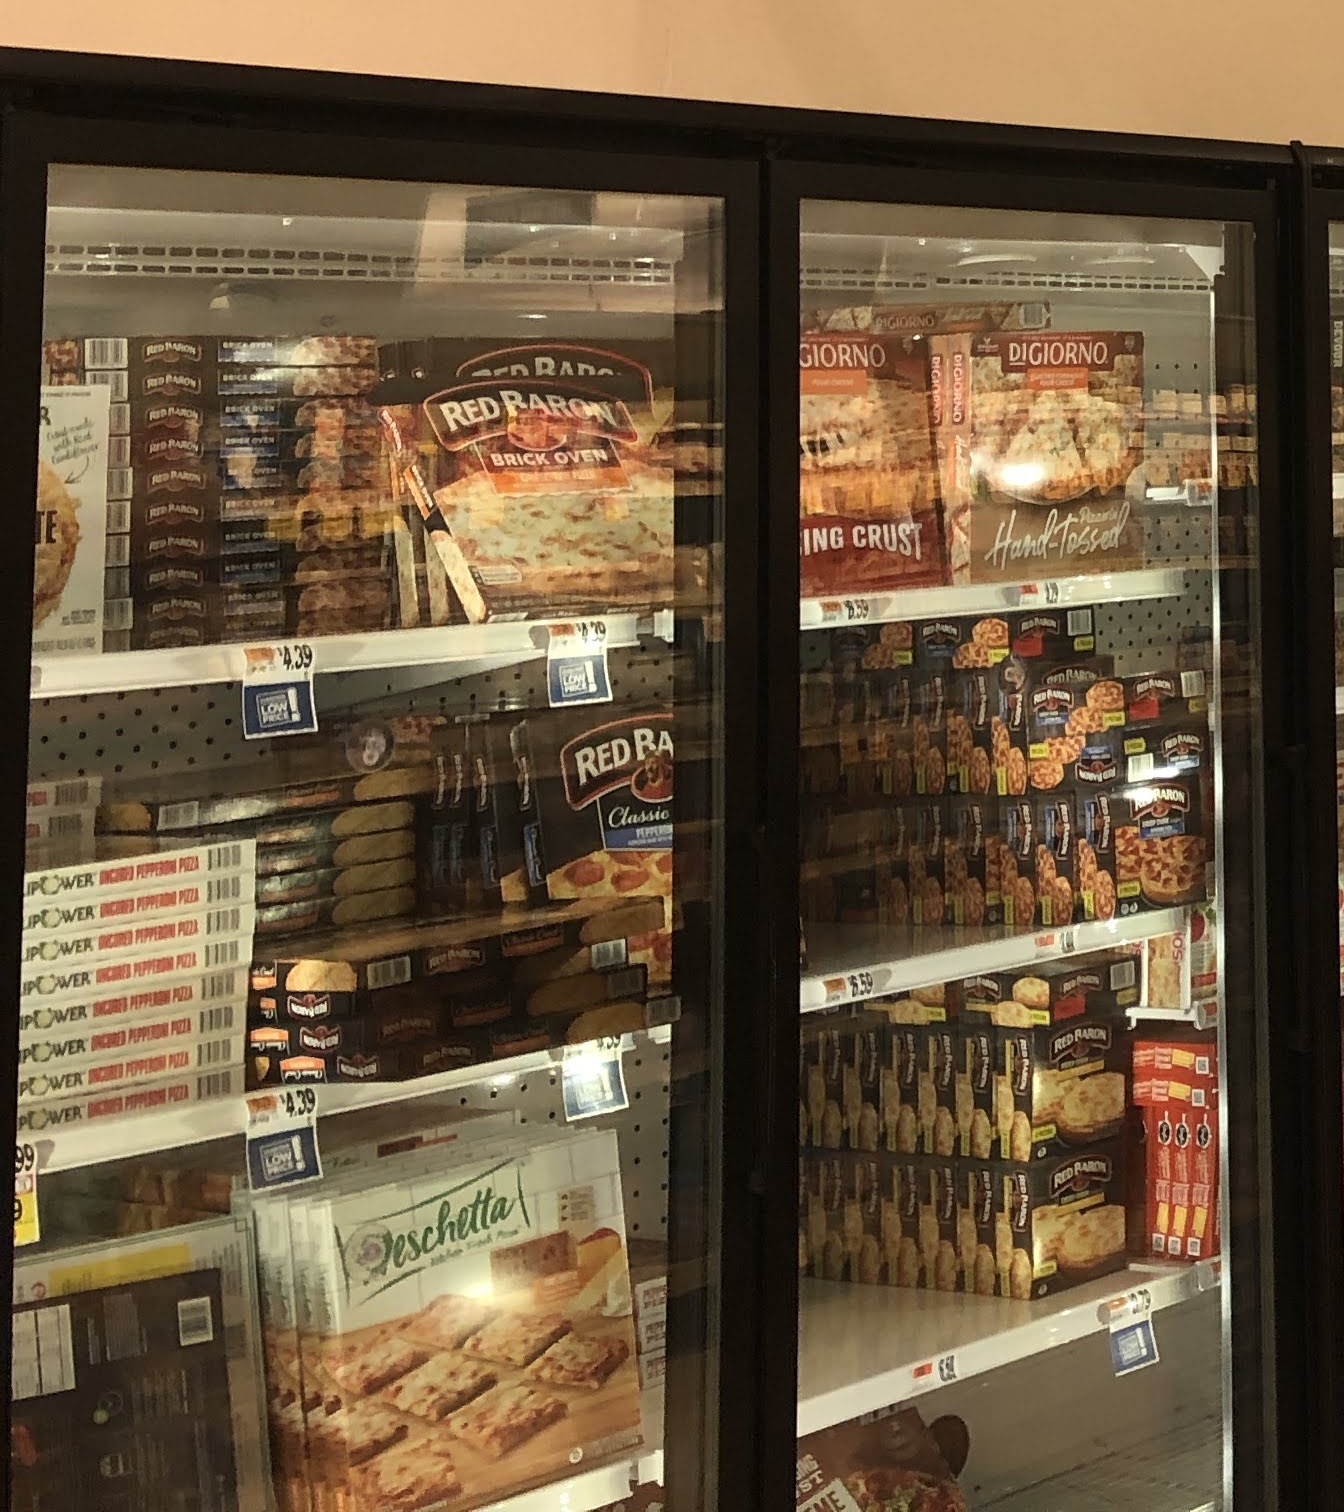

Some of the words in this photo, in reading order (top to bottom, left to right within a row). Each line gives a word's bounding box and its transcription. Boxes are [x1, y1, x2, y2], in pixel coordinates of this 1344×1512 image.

[800, 343, 886, 369] GIORNO
[1008, 342, 1108, 366] DIGIORNO
[1333, 320, 1344, 368] DEVOUR
[953, 353, 963, 424] DIGIORNO
[440, 397, 500, 432] RED
[500, 390, 617, 427] BARON
[490, 451, 549, 467] BRICK
[554, 449, 608, 466] OVEN
[800, 526, 844, 557] ING
[852, 522, 923, 561] CRUST
[984, 501, 1131, 571] Hand-Tossed
[261, 702, 288, 714] LOW
[574, 737, 631, 786] RED
[608, 806, 670, 828] Classic
[1055, 1034, 1074, 1052] RED
[1074, 1028, 1107, 1043] BARON
[281, 1087, 317, 1118] $4.39
[265, 1152, 292, 1166] LOW
[1053, 1169, 1074, 1188] RED
[1074, 1160, 1108, 1176] BARON
